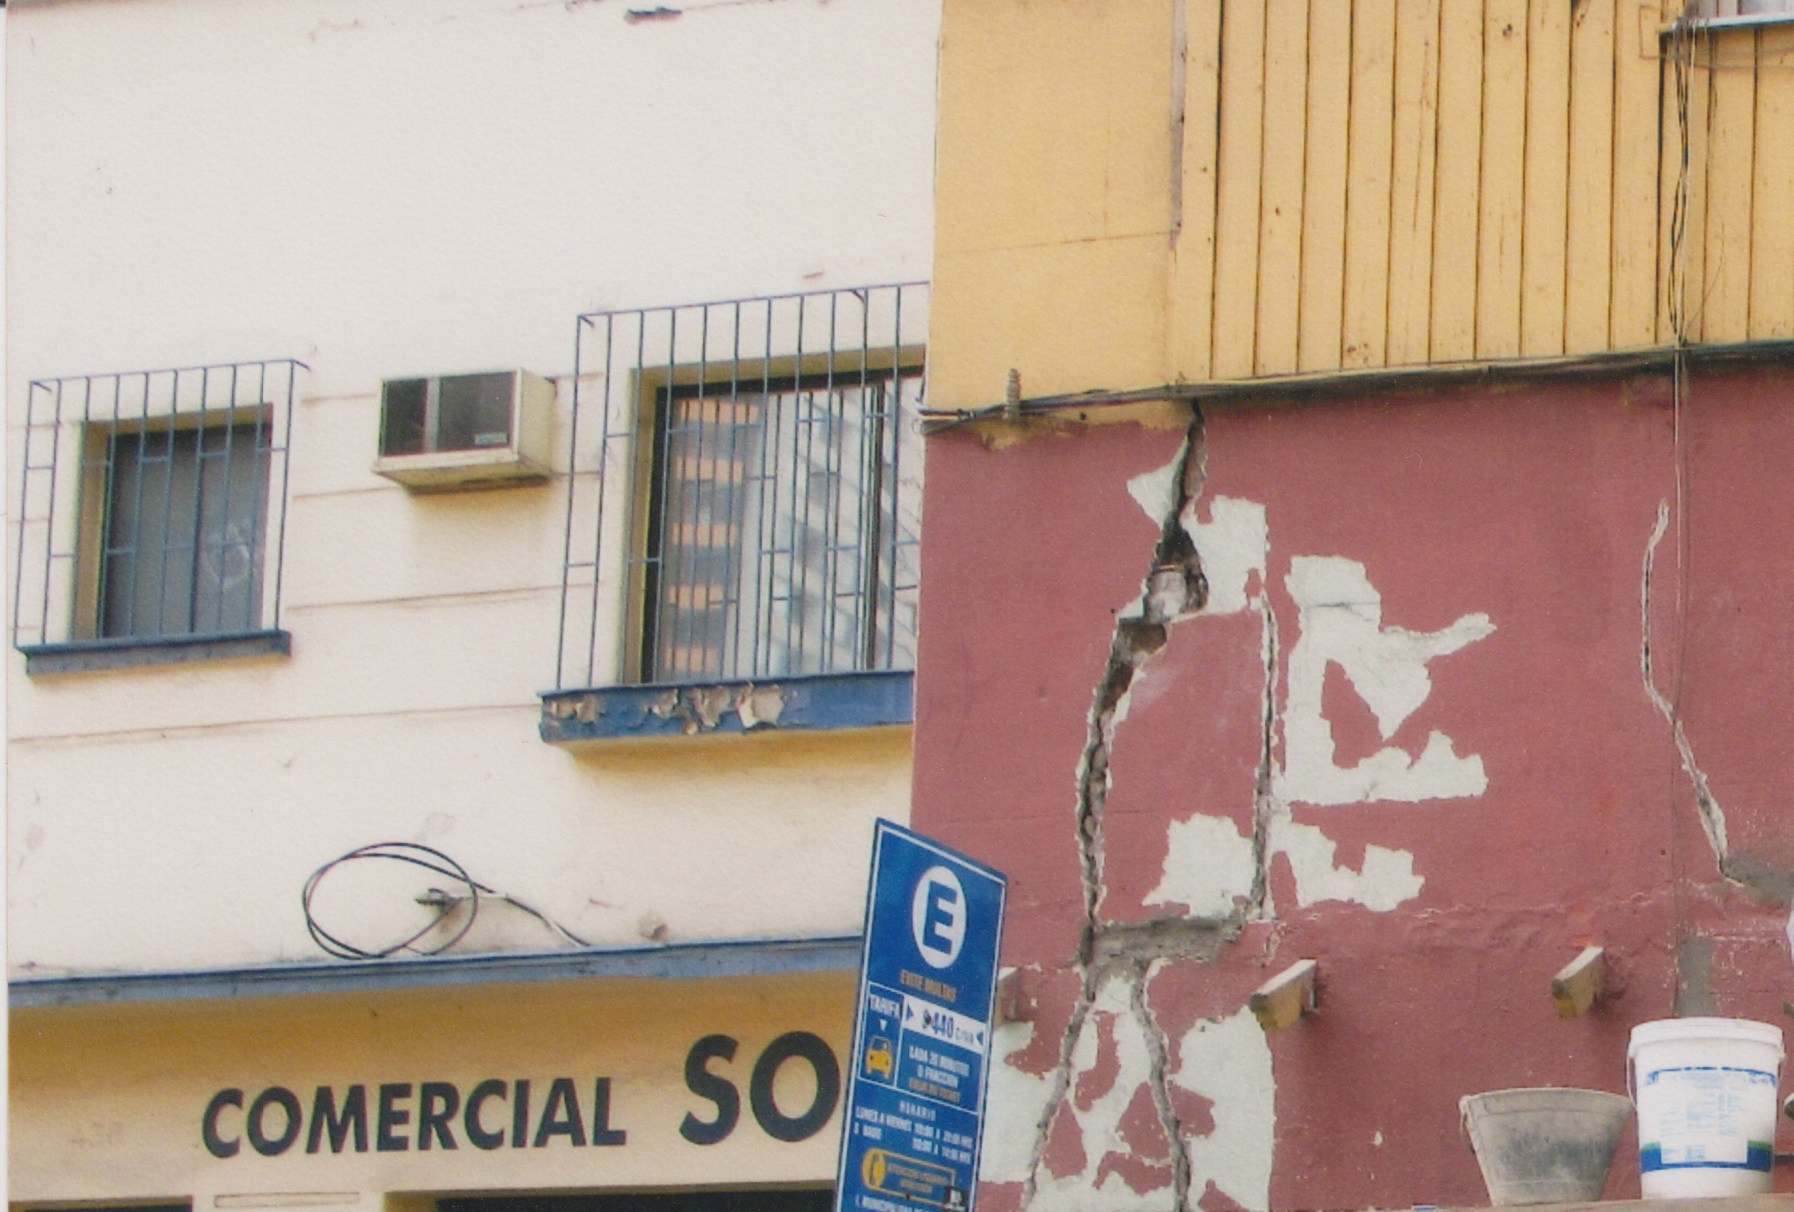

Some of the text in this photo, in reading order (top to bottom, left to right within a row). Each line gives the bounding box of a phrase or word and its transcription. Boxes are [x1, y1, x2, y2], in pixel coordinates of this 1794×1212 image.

[922, 880, 958, 956] E
[202, 1030, 841, 1159] COMERCIAL SO
